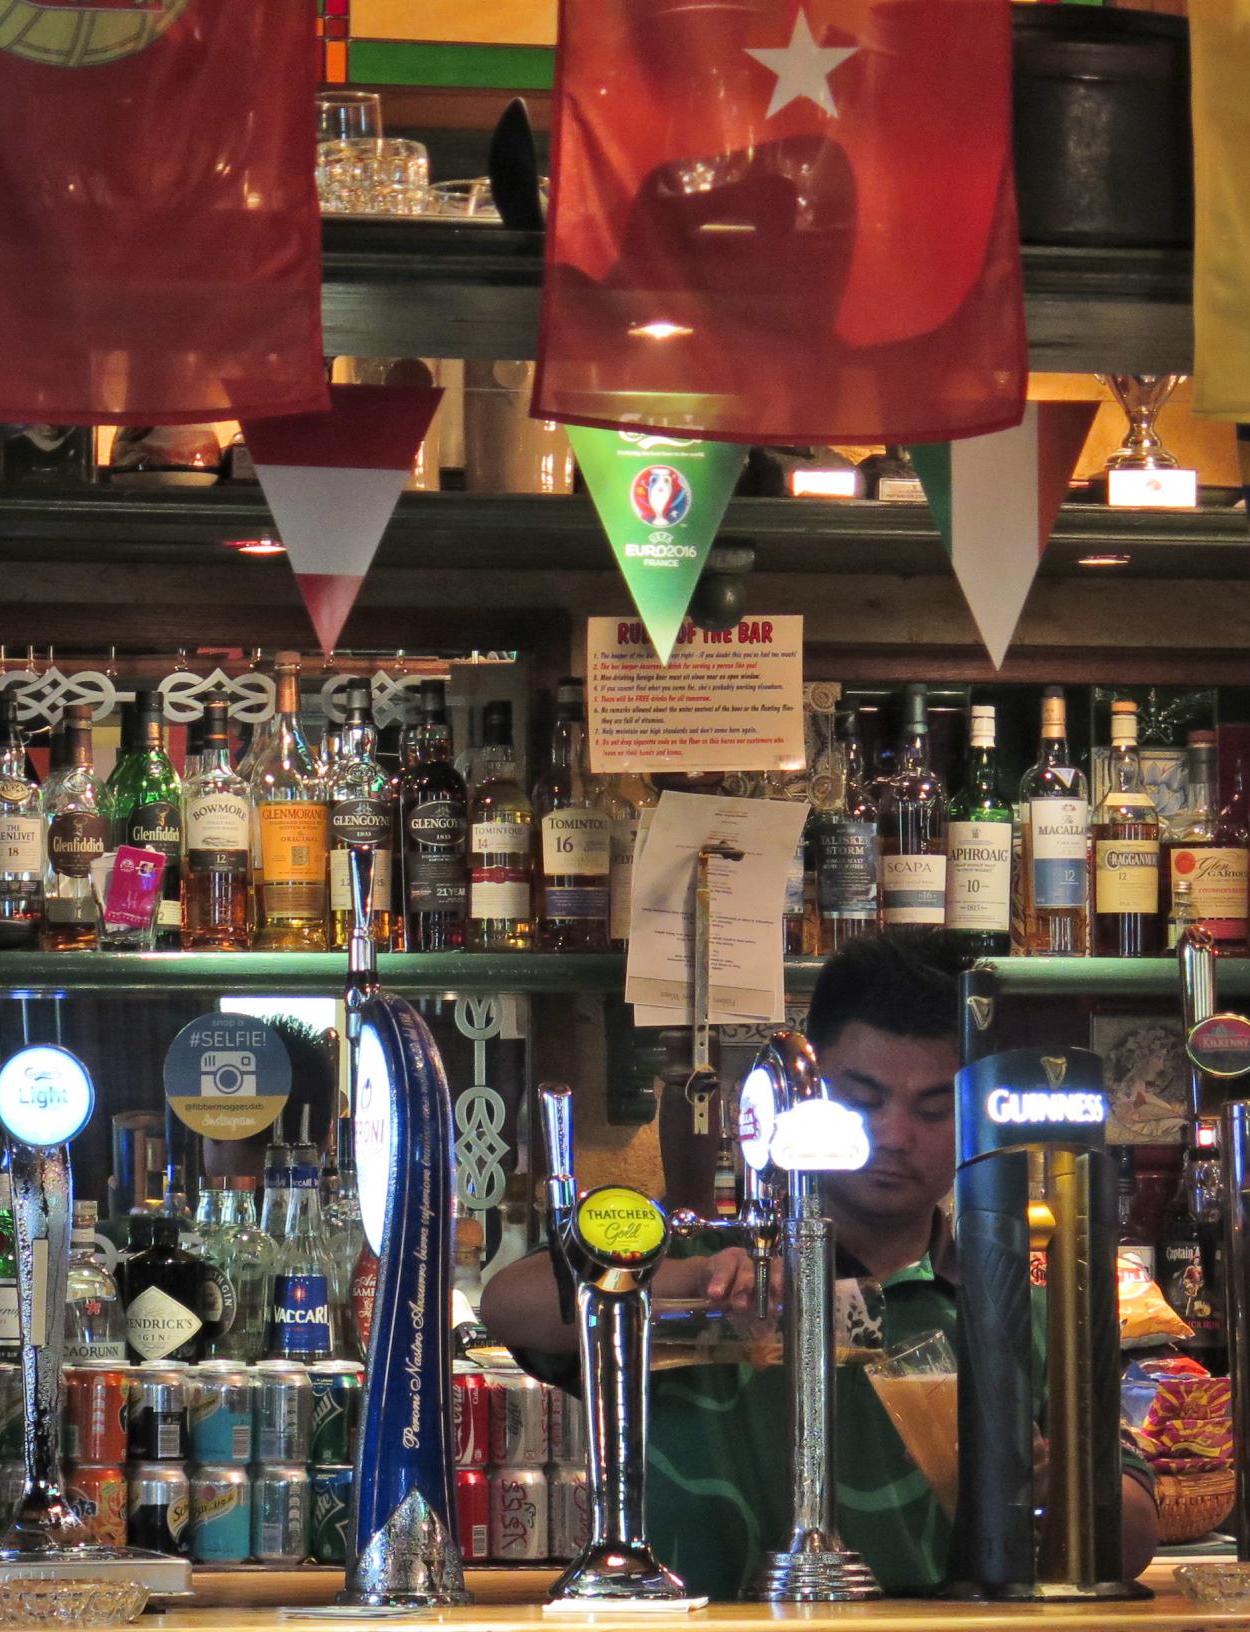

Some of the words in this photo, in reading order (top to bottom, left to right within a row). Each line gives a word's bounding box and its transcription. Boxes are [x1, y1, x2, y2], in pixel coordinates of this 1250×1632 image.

[624, 543, 698, 559] EURO2016
[642, 558, 680, 568] FRANCE
[737, 621, 774, 645] BAR
[192, 802, 247, 822] BOWMORE
[261, 804, 327, 820] GLENMORAN
[332, 814, 391, 827] GLENGOYN
[6, 824, 21, 832] THE
[1038, 825, 1087, 836] MACALLA
[478, 838, 489, 850] 14
[555, 836, 574, 853] 16
[825, 846, 865, 855] STORM
[7, 847, 19, 857] 18
[951, 848, 1008, 863] APHROAIG
[215, 854, 227, 864] 12
[886, 861, 933, 874] SCAPA
[1064, 870, 1075, 882] 12
[1118, 872, 1127, 881] 12
[436, 888, 448, 897] 21
[966, 879, 981, 893] 10
[189, 1031, 268, 1048] #SELFIE!
[1203, 1039, 1250, 1048] KILKENNY
[18, 1086, 69, 1109] Light
[986, 1088, 1105, 1123] GUINNESS
[355, 1119, 384, 1144] ERONI
[586, 1208, 656, 1221] THATCHERS
[604, 1222, 643, 1246] Gold
[1165, 1247, 1193, 1262] Captain
[409, 1263, 427, 1330] Azzurro
[129, 1318, 193, 1330] ENDRICK'S
[142, 1333, 166, 1342] GIN
[405, 1331, 424, 1392] Nastro
[401, 1392, 421, 1450] Peroni
